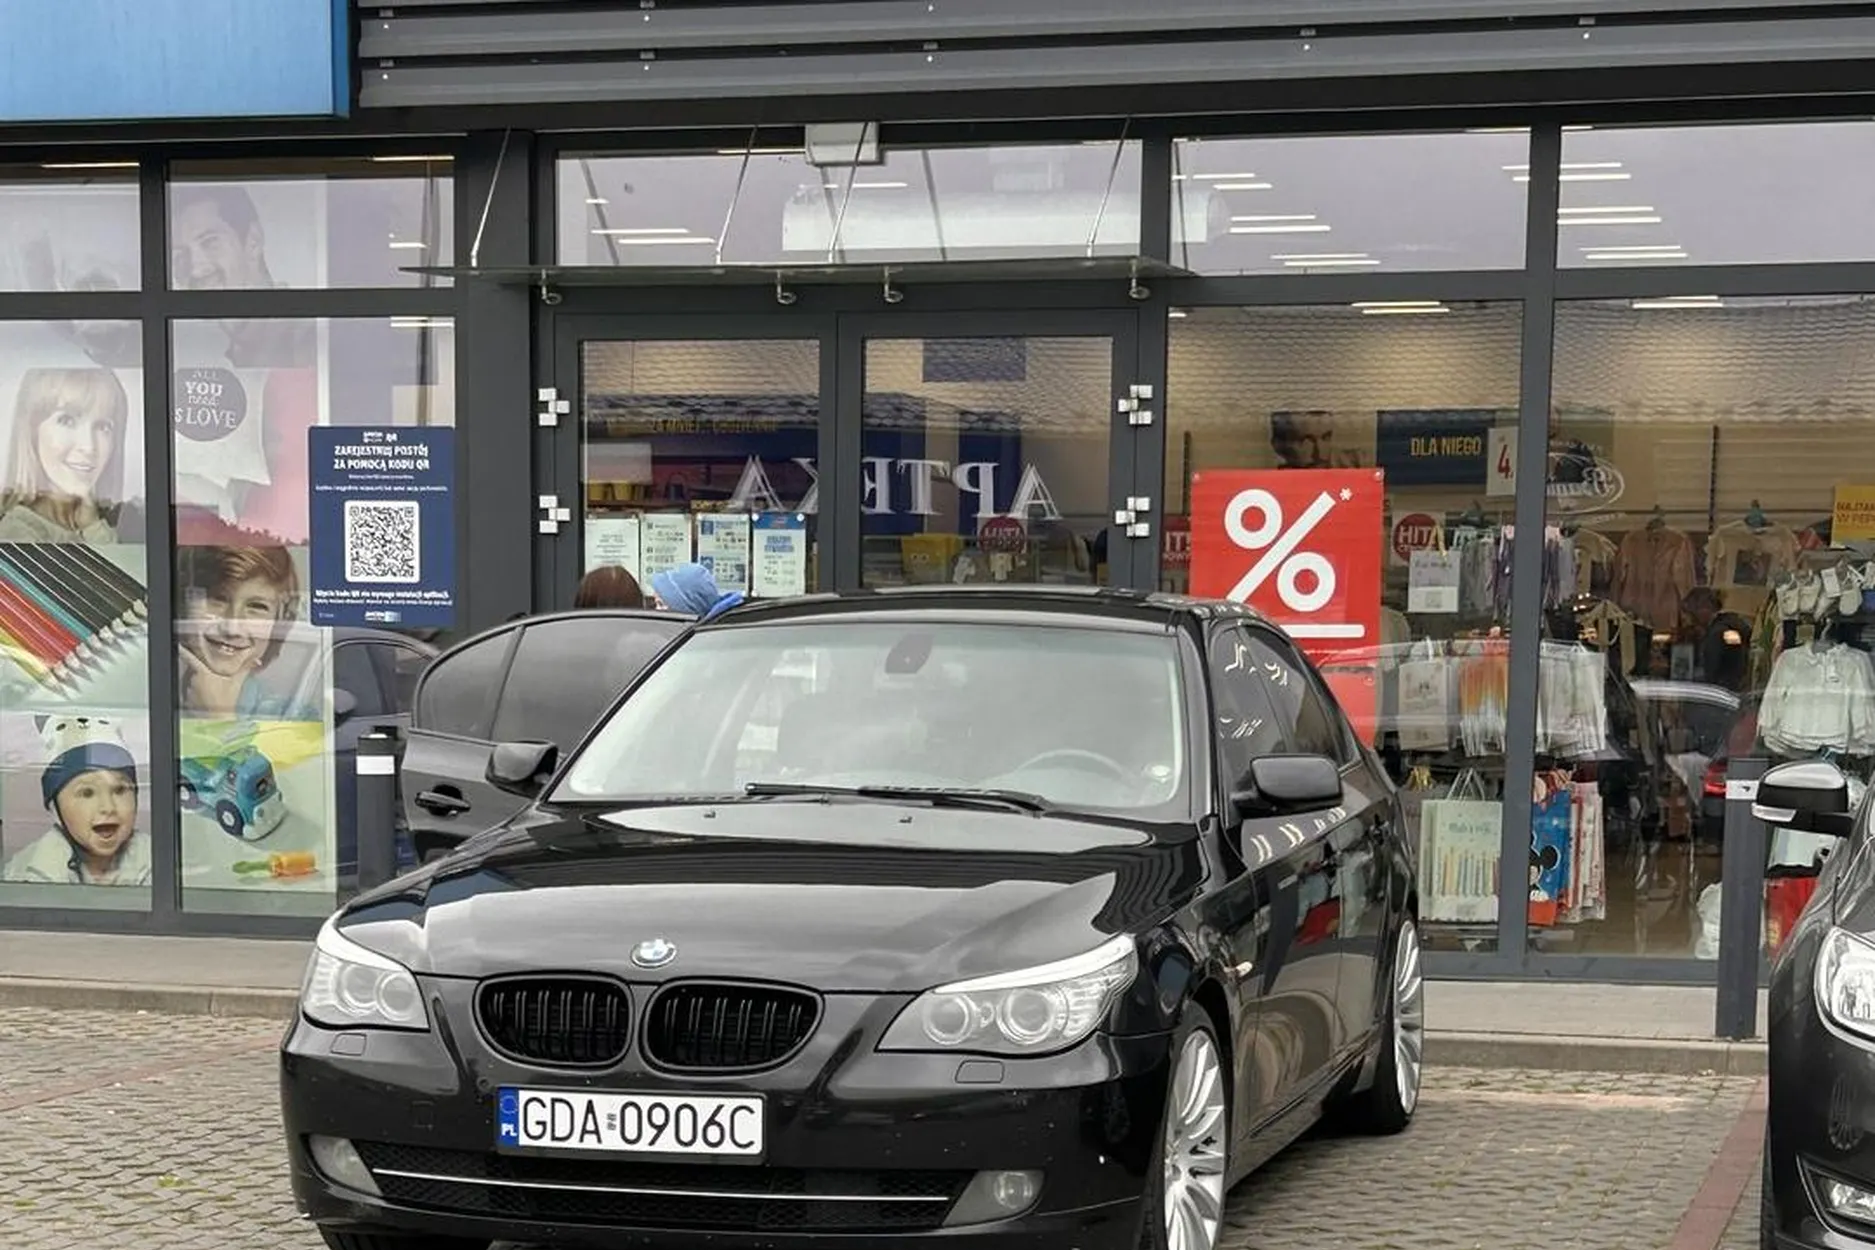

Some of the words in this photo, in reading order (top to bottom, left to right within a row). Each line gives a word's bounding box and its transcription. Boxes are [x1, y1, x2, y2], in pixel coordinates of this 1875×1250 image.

[185, 381, 223, 396] YOU
[186, 407, 237, 429] LOVE
[334, 445, 393, 457] ZAREJESTRUJ
[394, 443, 429, 457] POSTÓJ
[1410, 437, 1437, 456] DLA
[1440, 436, 1481, 456] NIEGO
[333, 459, 346, 470] ZA
[347, 459, 387, 471] POMOCĄ
[388, 459, 414, 470] KODU
[416, 459, 430, 471] QR
[1165, 531, 1191, 552] IT!
[1398, 525, 1432, 545] HIT
[501, 1122, 518, 1137] PL
[523, 1097, 603, 1145] GDA
[619, 1100, 755, 1149] 0906C
